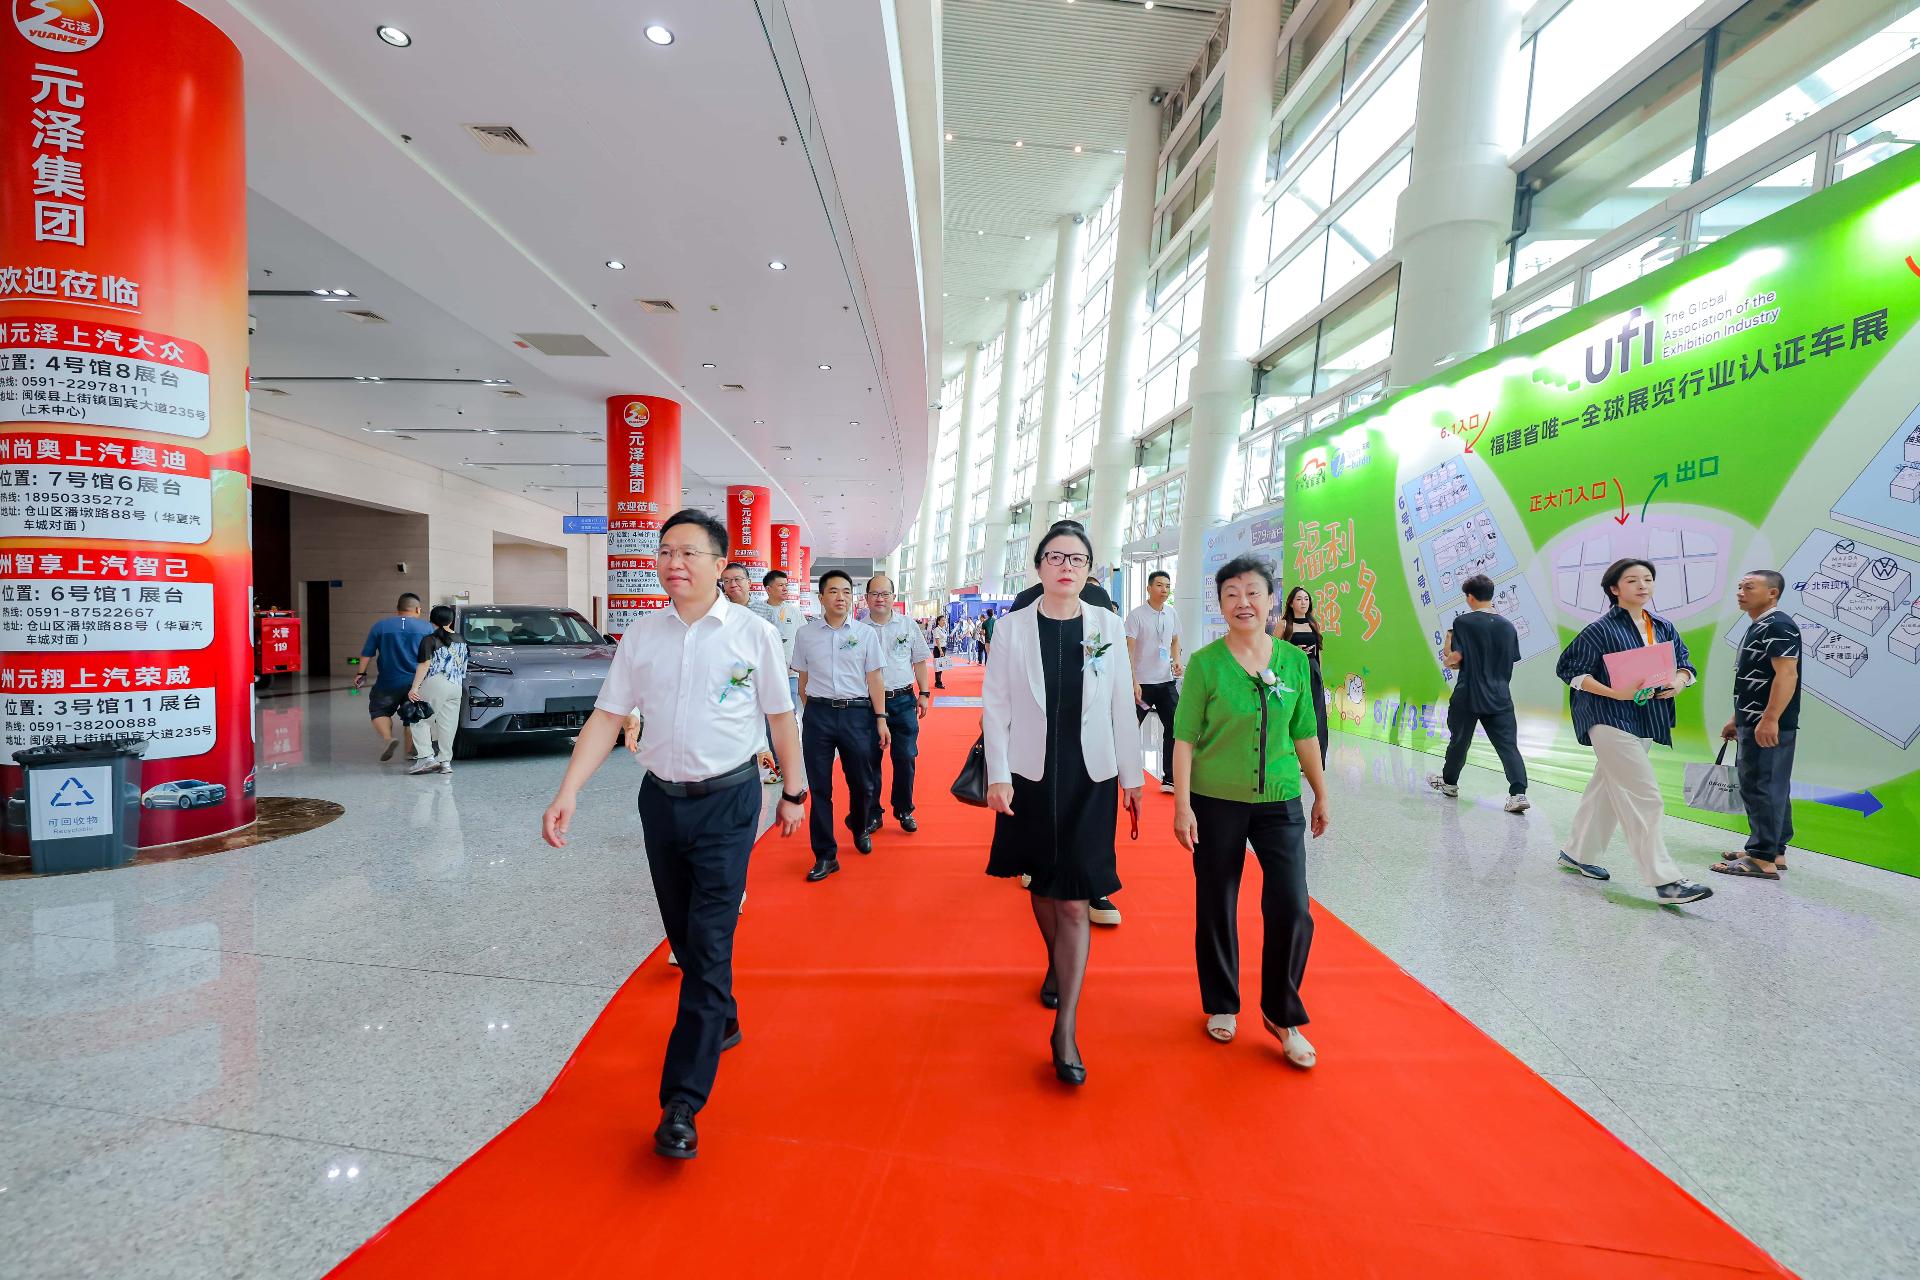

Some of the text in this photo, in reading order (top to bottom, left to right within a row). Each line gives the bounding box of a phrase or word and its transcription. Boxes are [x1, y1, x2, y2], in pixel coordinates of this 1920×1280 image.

[29, 29, 88, 46] YUANZE
[60, 17, 91, 33] 元泽
[31, 63, 85, 246] 元泽集团
[0, 266, 139, 306] 欢迎莅临
[1663, 292, 1775, 342] Association of the
[1664, 293, 1727, 325] The Global
[1585, 306, 1655, 385] ufi
[1663, 308, 1779, 358] Exhibition Industry
[1490, 307, 1889, 457] 福建省唯一全球展览行业认证车展
[1440, 414, 1479, 439] 6.1入口
[628, 431, 645, 494] 元泽集团
[1676, 455, 1719, 483] 出口
[1529, 481, 1606, 513] 正大门入口
[1398, 494, 1416, 542] 6号馆
[1292, 518, 1356, 580] 福利
[1414, 558, 1431, 605] 7号馆
[1812, 580, 1850, 590] 北京现代
[272, 628, 290, 639] 火警
[274, 642, 288, 652] 119
[1, 666, 191, 689] 州元翔上汽荣威
[48, 816, 98, 827] 可回收物
